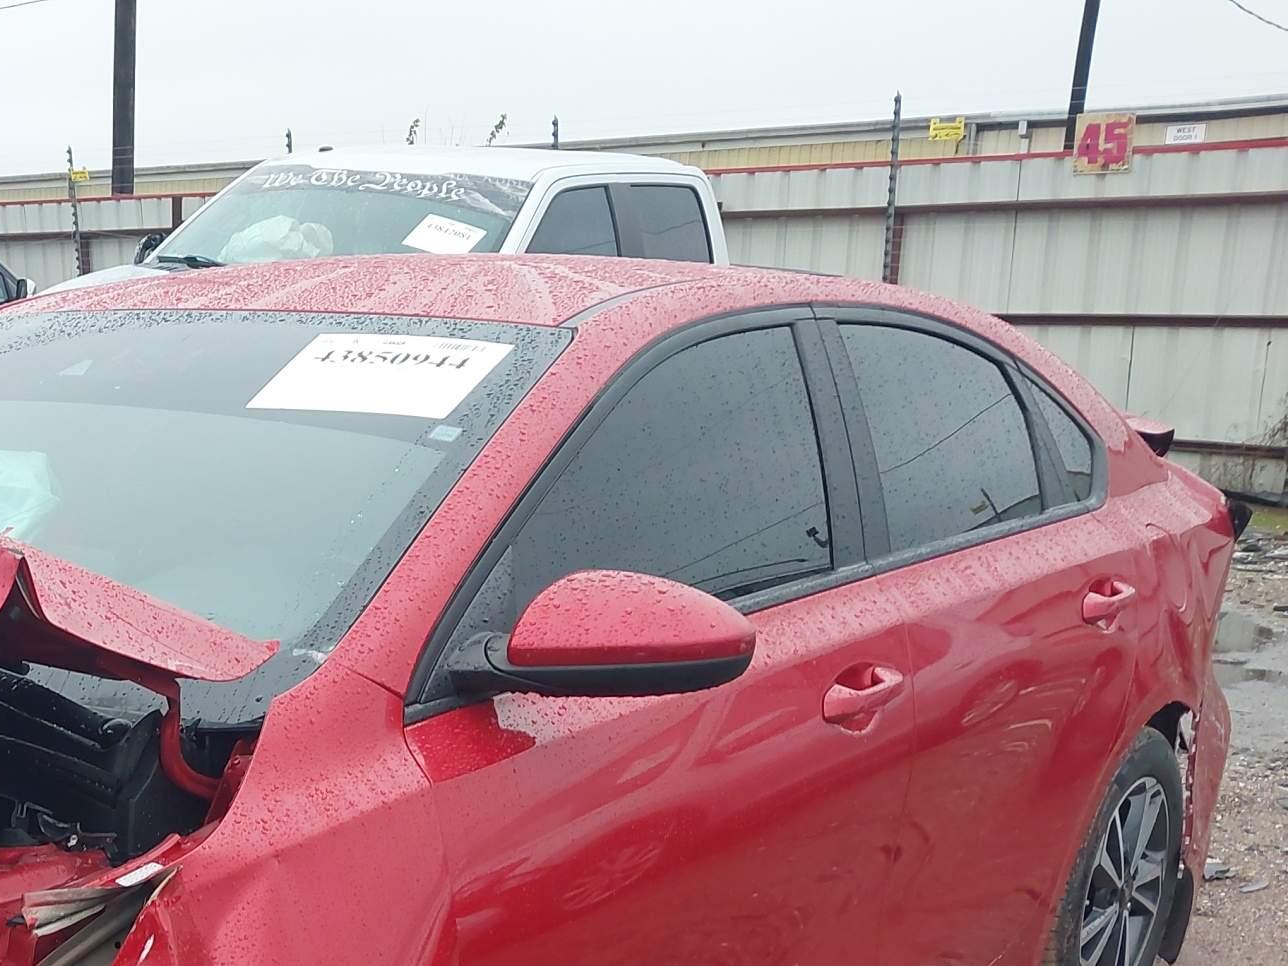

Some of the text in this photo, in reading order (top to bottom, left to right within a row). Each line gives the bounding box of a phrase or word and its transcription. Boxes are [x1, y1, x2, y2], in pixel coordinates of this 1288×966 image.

[1173, 134, 1192, 142] DOOR
[1176, 126, 1197, 134] WEST
[1077, 121, 1130, 168] 45
[359, 171, 465, 201] People
[314, 350, 471, 369] 43850944
